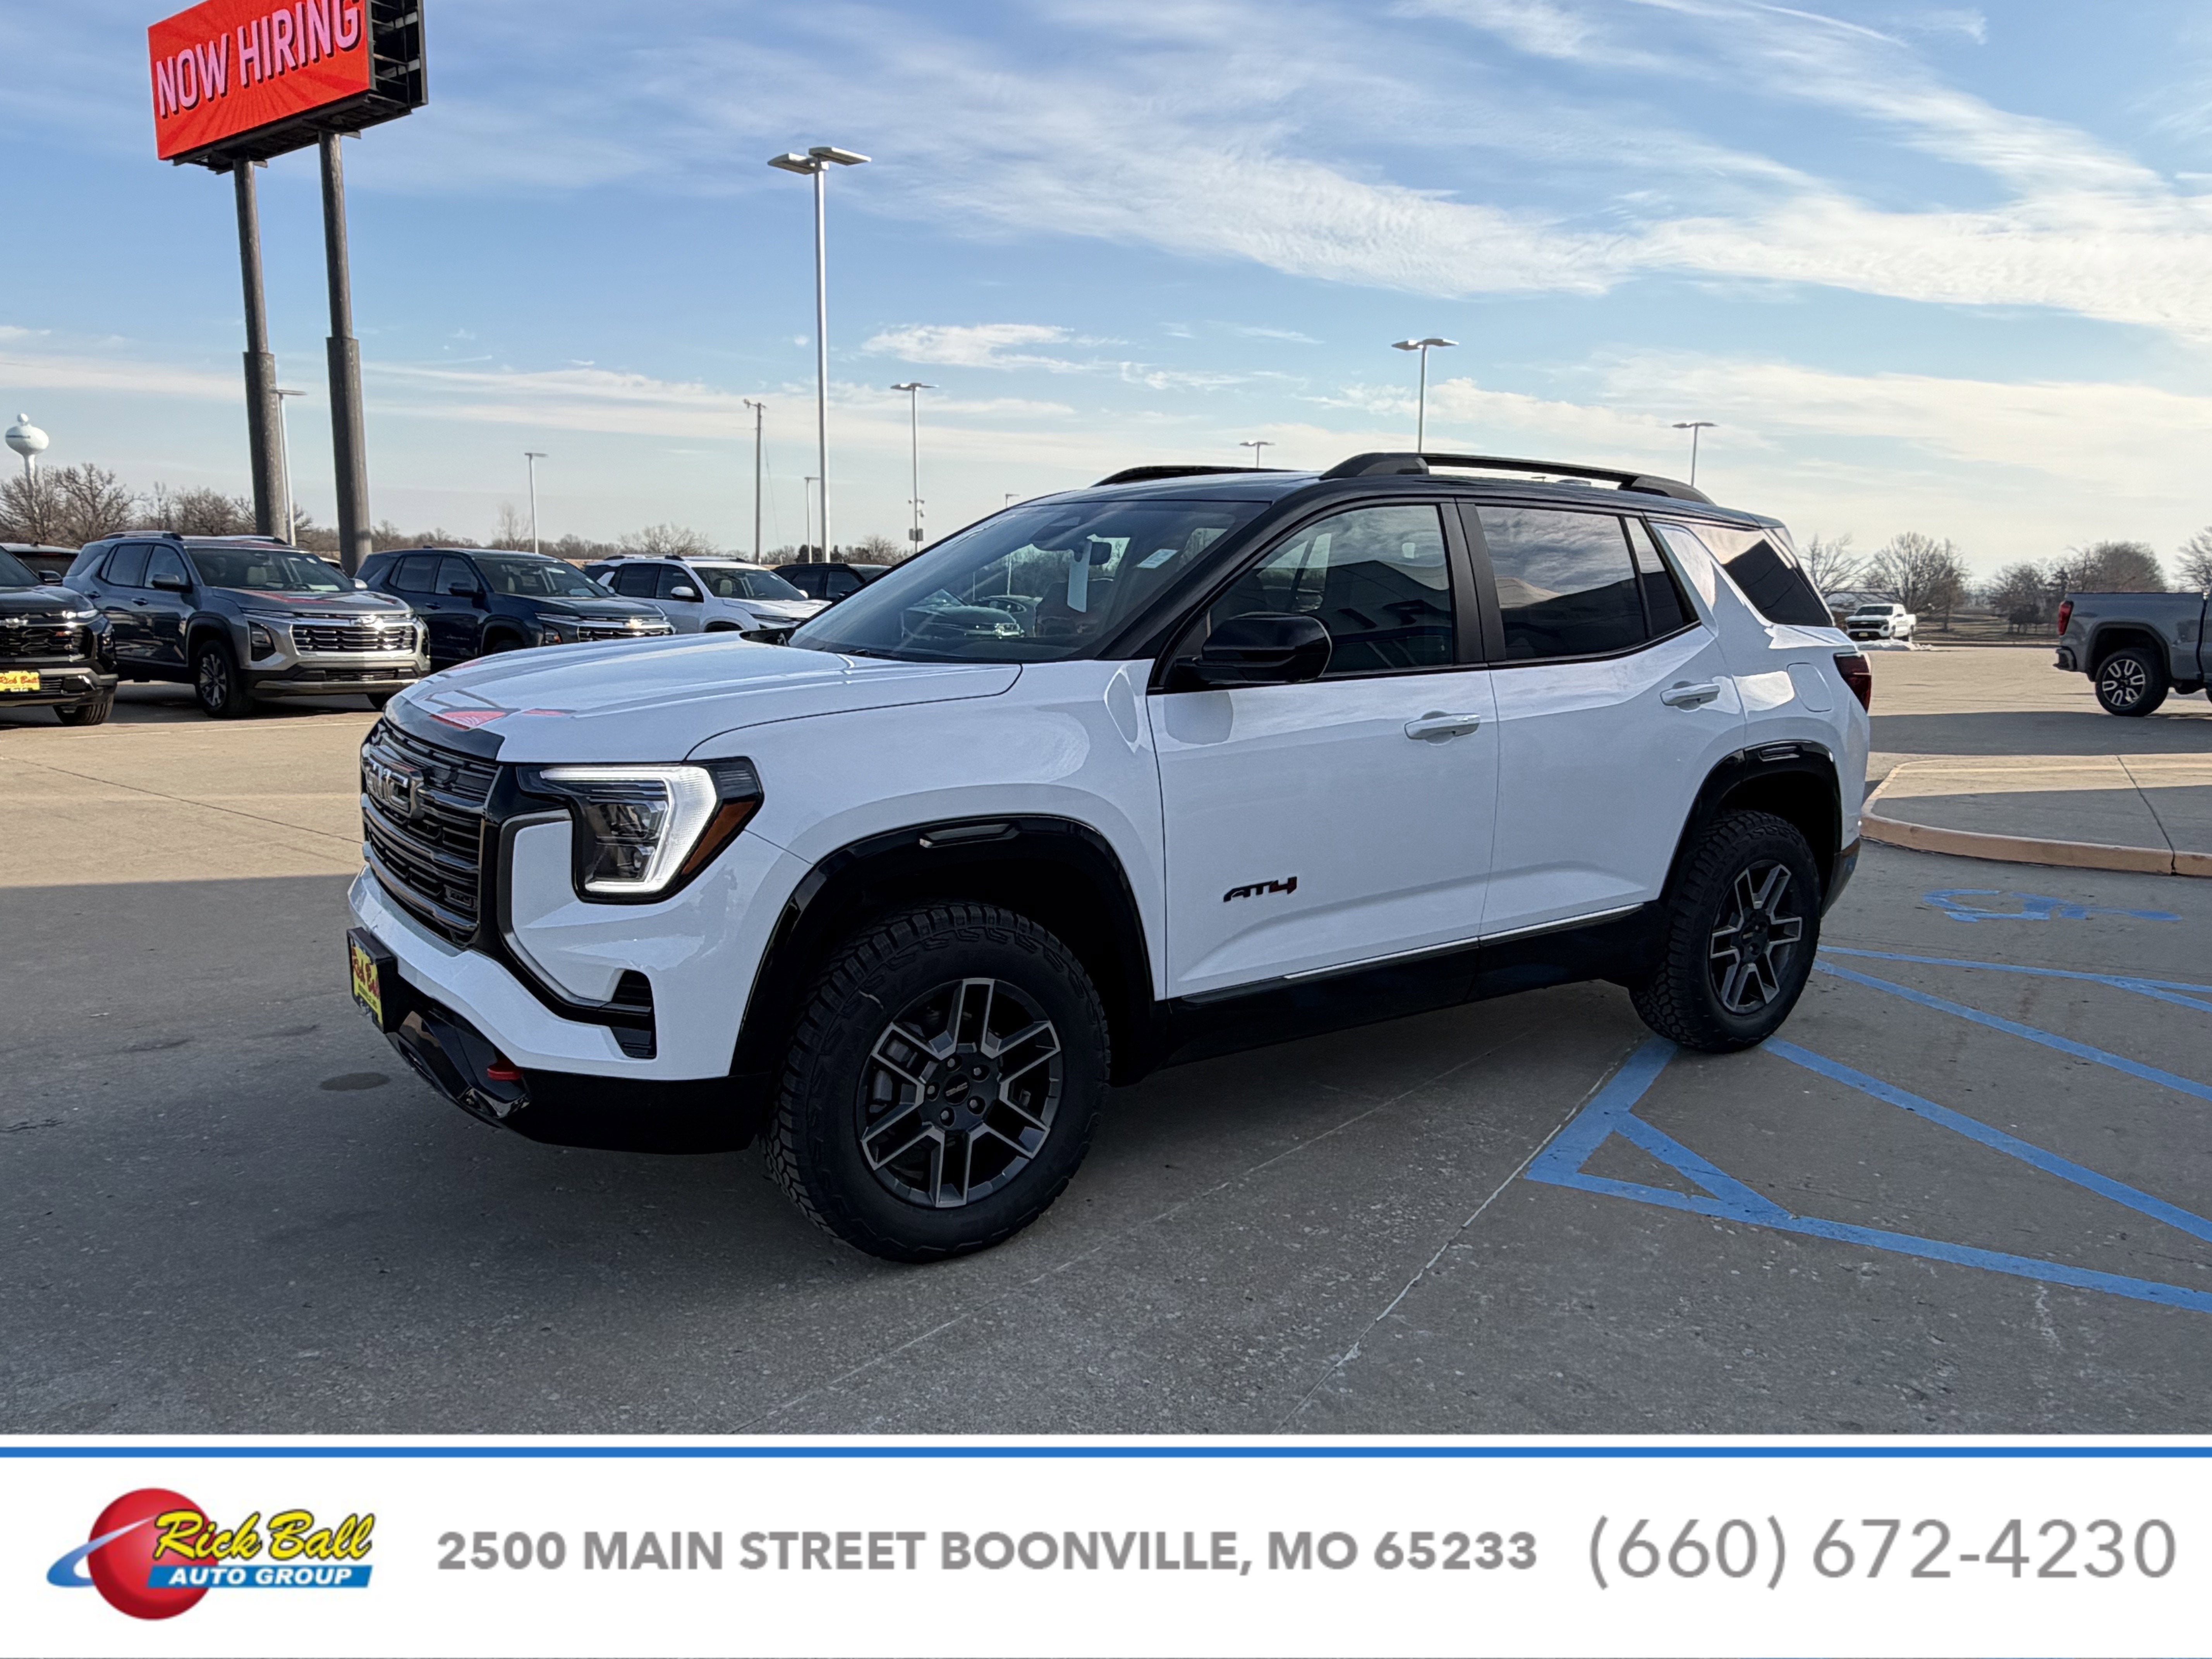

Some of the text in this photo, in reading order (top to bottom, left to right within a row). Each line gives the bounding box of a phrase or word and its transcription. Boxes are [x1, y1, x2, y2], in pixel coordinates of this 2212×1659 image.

[156, 0, 360, 117] NOW HIRING
[1223, 876, 1297, 902] AT4
